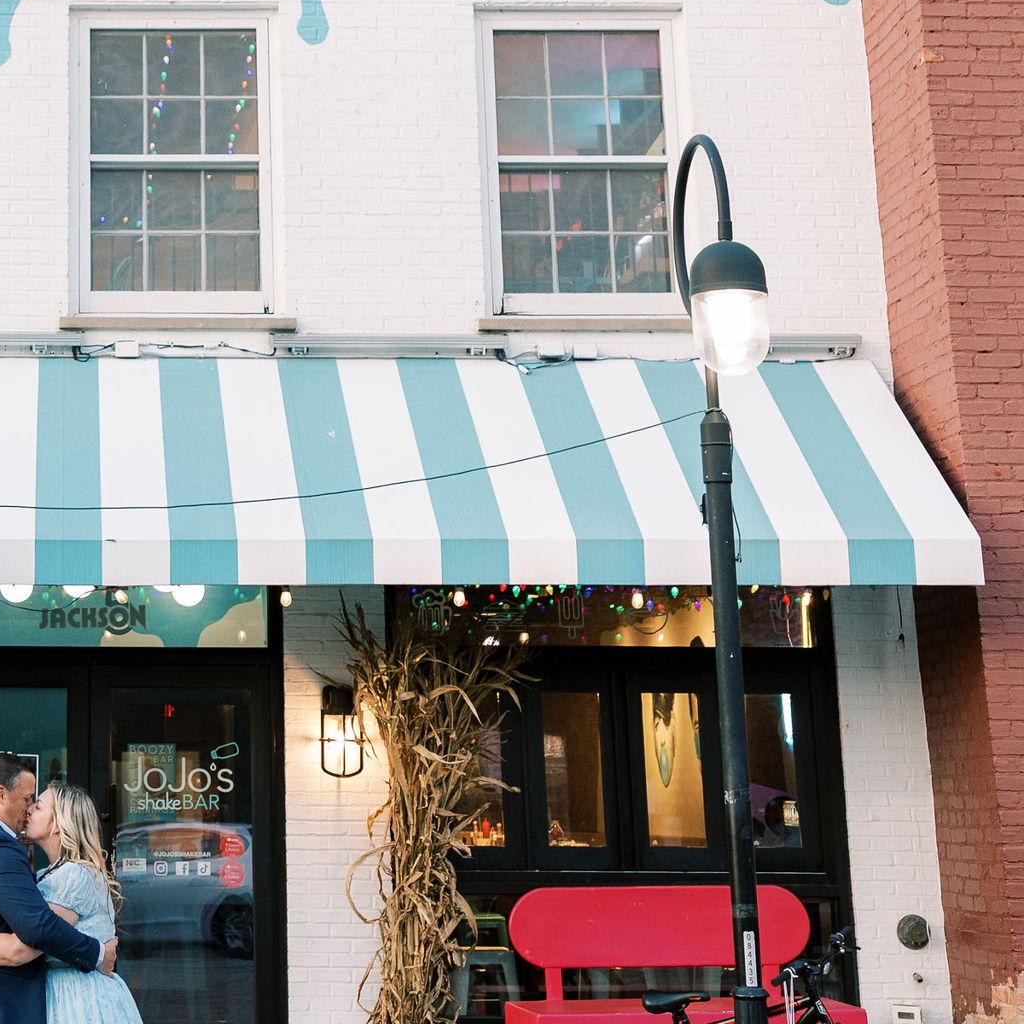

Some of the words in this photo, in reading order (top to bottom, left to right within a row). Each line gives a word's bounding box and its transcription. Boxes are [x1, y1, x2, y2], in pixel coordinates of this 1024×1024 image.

[39, 603, 146, 630] JACKSON
[137, 791, 219, 811] shakeBAR
[746, 933, 755, 985] 084435
